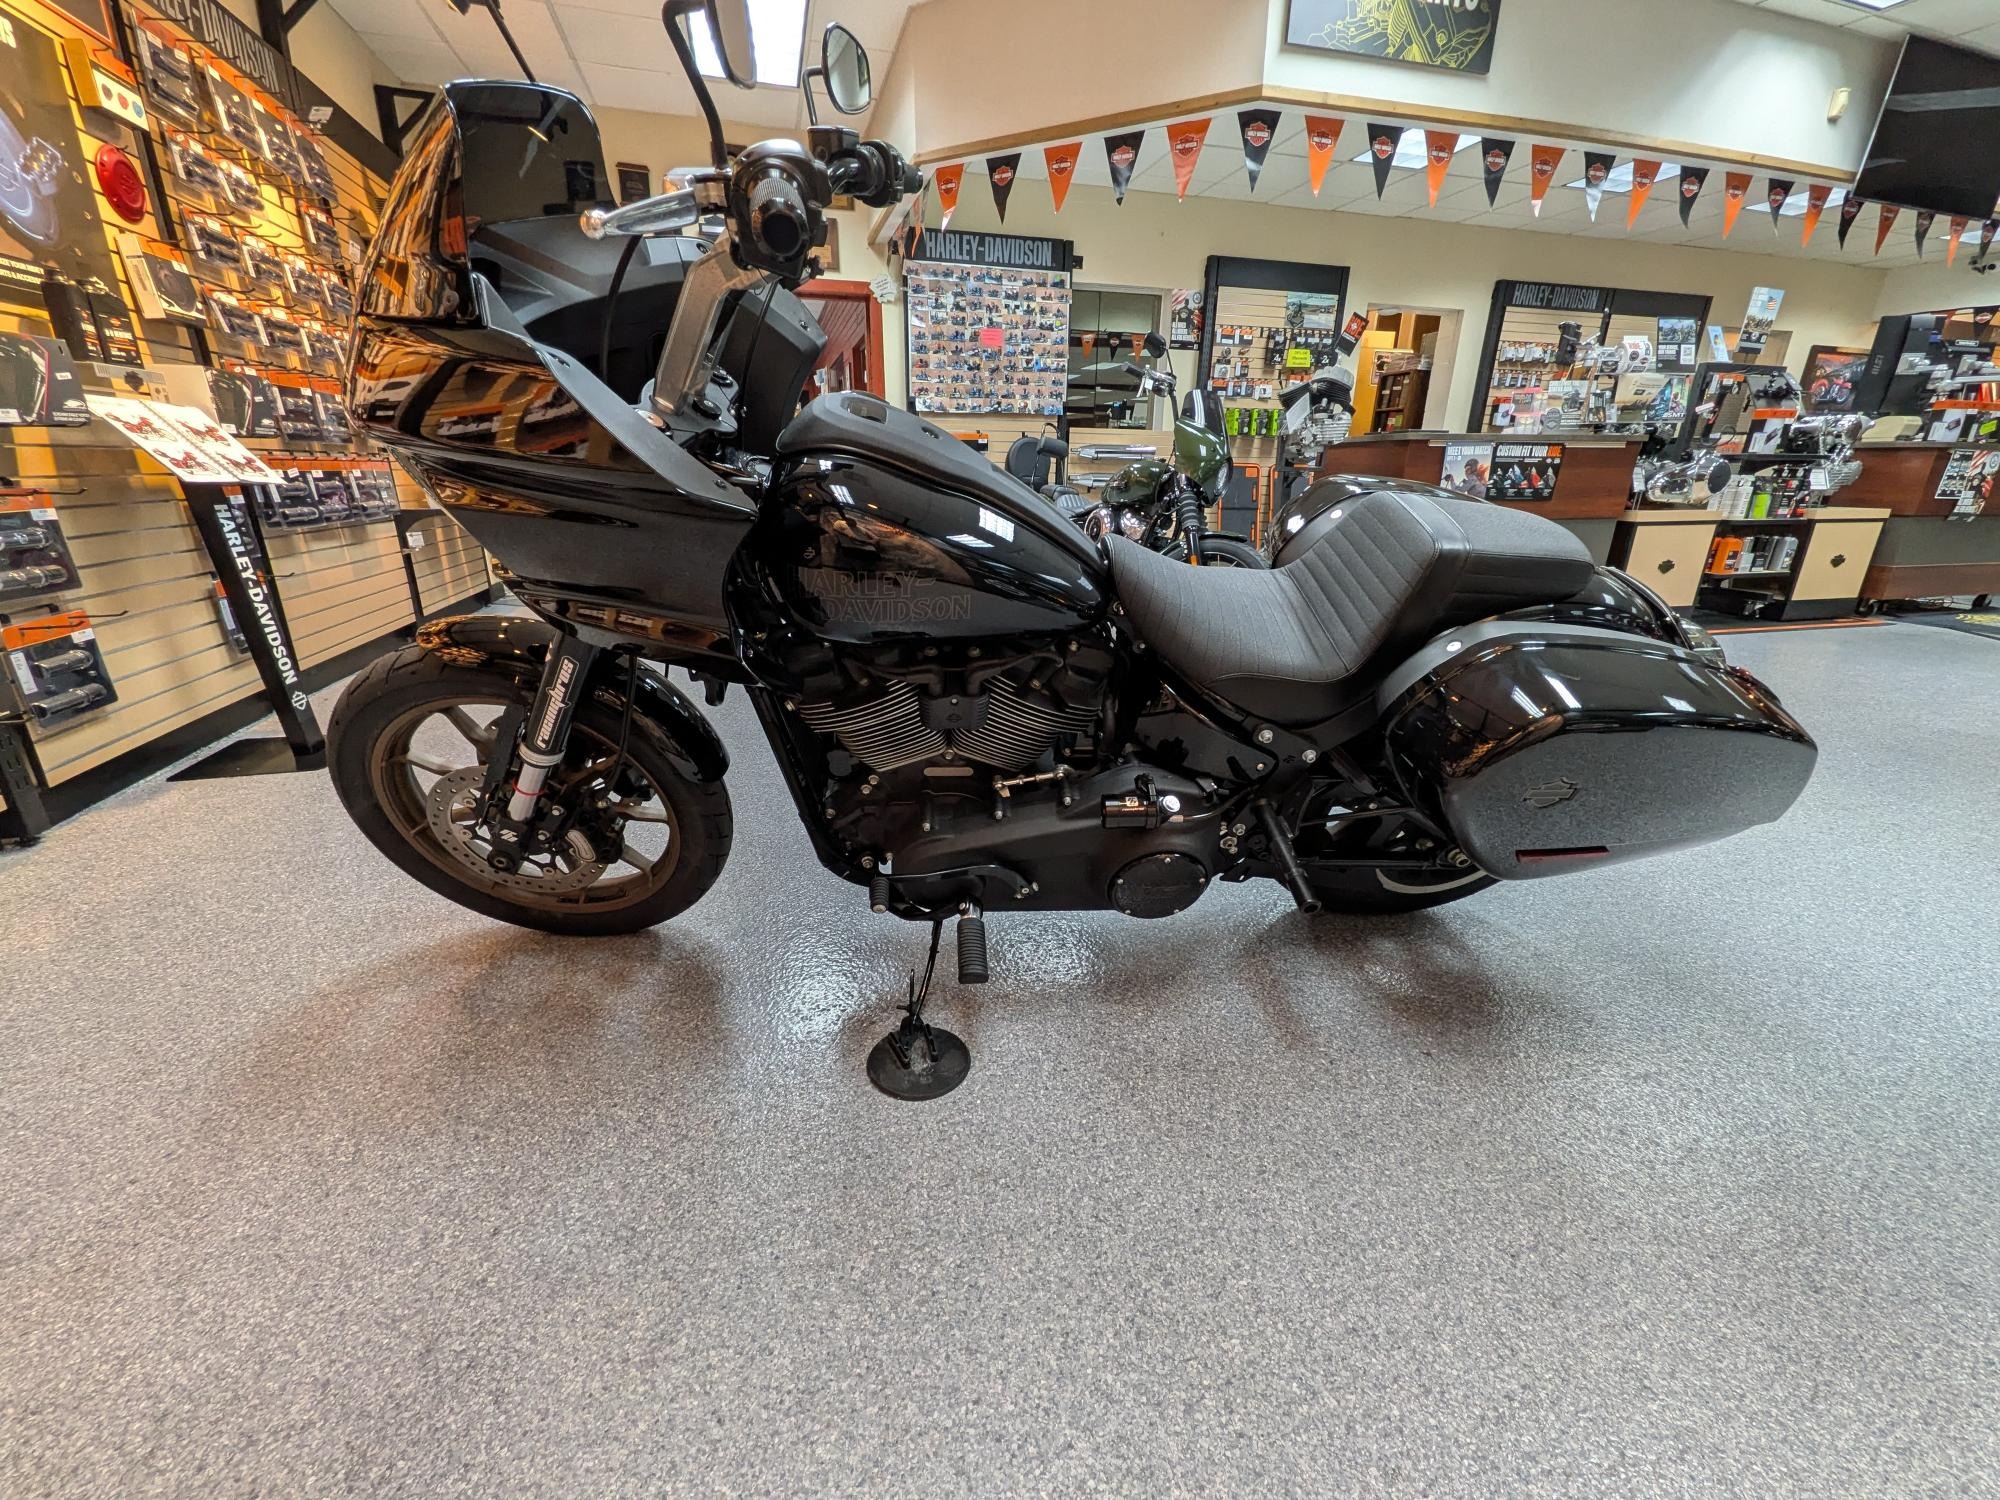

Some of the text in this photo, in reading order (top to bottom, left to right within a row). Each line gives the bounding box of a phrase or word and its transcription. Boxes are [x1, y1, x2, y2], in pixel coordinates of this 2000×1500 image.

[925, 231, 1052, 267] HARLEY-DAVIDSON
[1512, 283, 1600, 311] HARLEY-DAVIDSON
[1496, 445, 1522, 457] CUSTOM
[1521, 445, 1532, 457] FIT
[1531, 445, 1549, 457] YOUR
[213, 504, 298, 686] HARLEY-DAVIDSON
[826, 594, 971, 625] DAVIDSON
